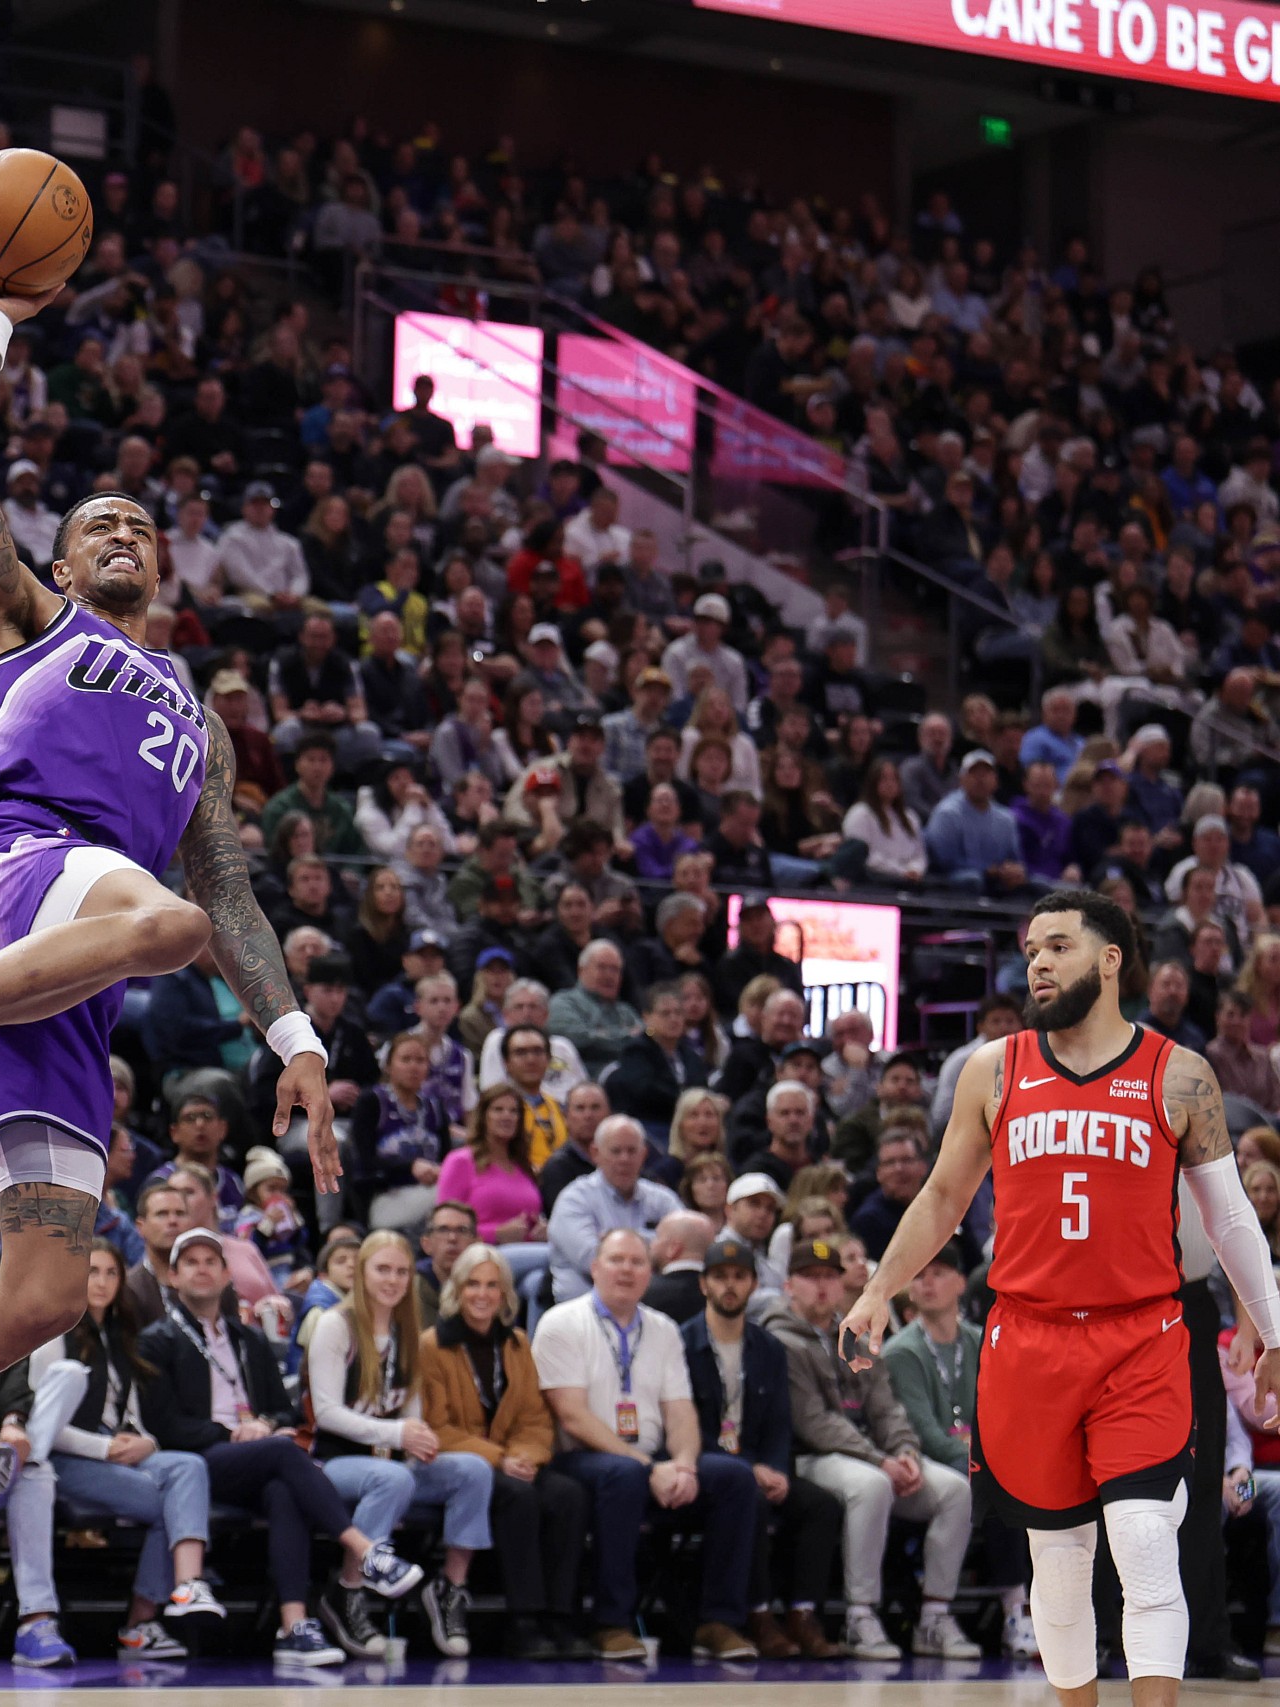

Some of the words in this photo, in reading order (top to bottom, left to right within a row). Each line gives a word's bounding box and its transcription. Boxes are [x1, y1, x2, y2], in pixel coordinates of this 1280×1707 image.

[951, 0, 1084, 53] CARE
[1091, 0, 1158, 65] TO
[1166, 4, 1226, 77] BE
[65, 639, 208, 733] UTAH
[138, 710, 199, 793] 20
[1109, 1086, 1148, 1100] karma
[1111, 1078, 1148, 1091] credit
[1008, 1109, 1152, 1169] ROCKETS
[1061, 1172, 1090, 1241] 5
